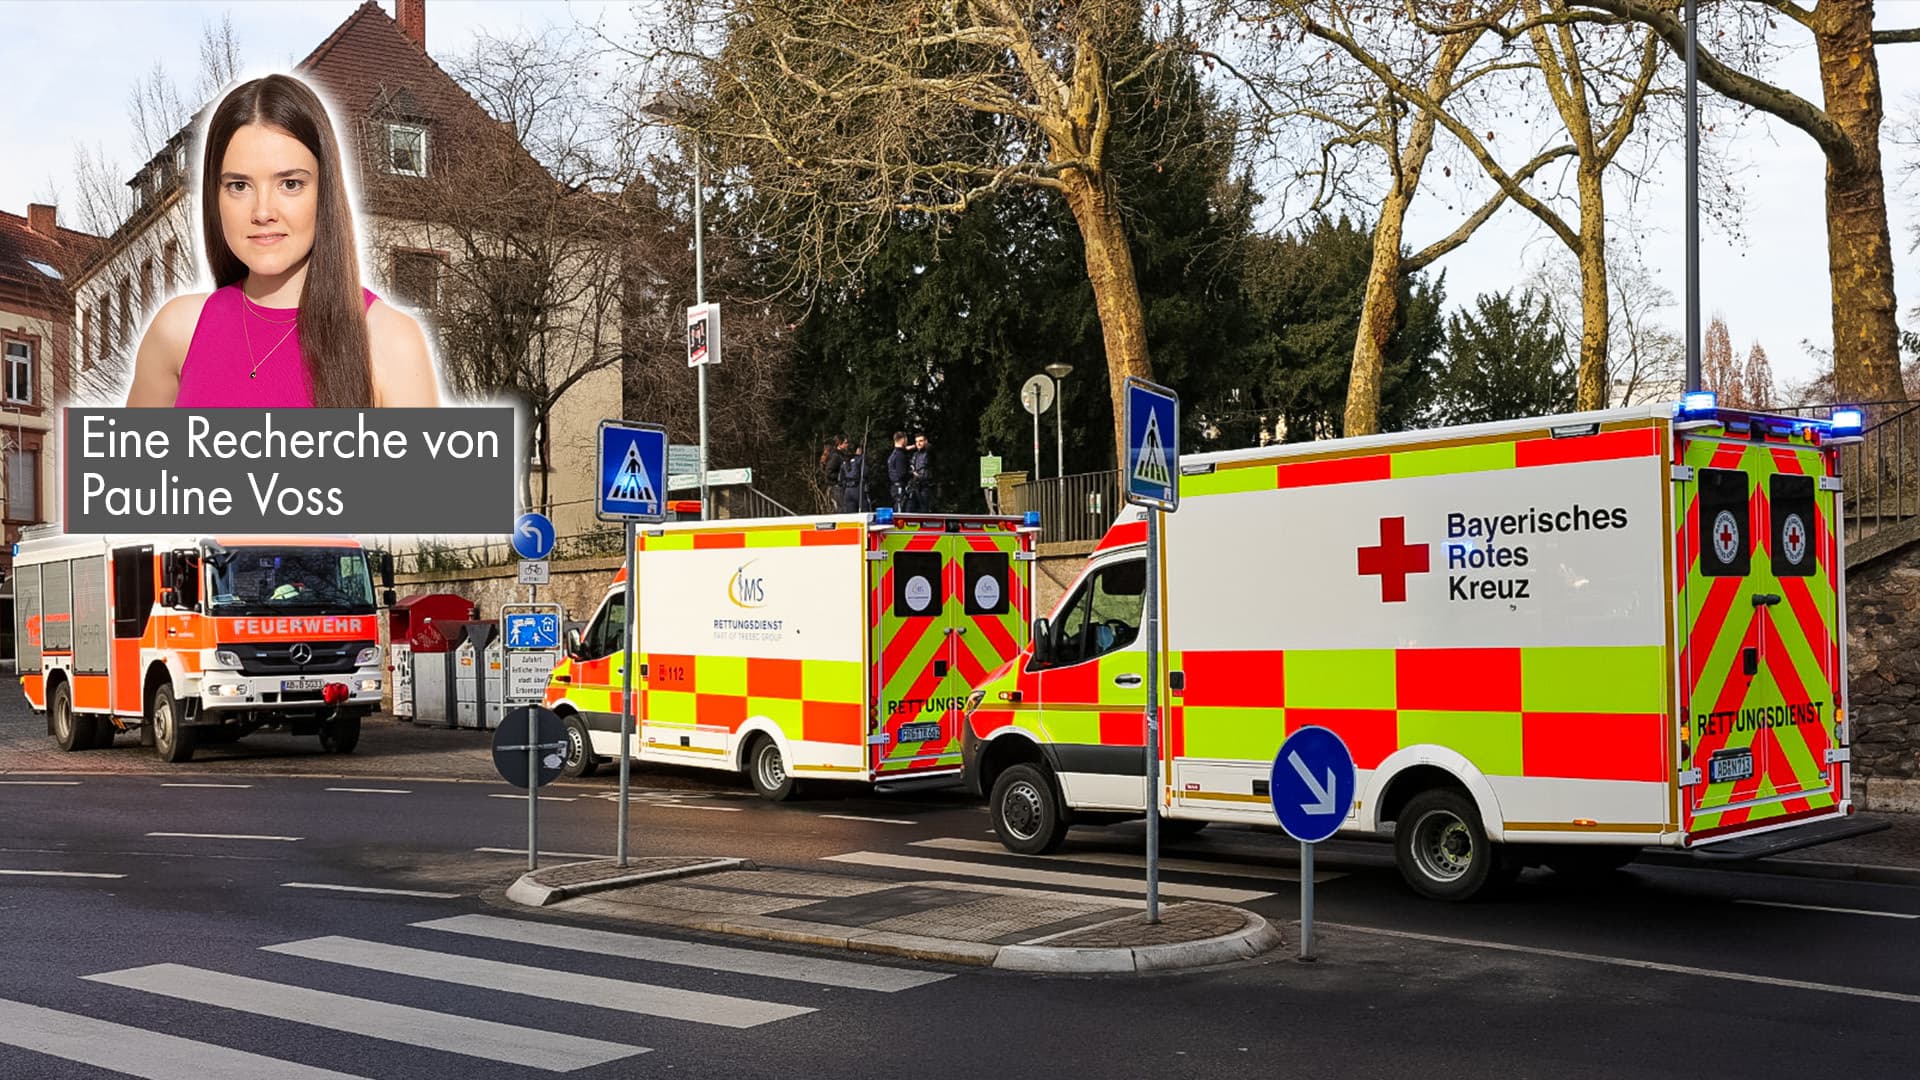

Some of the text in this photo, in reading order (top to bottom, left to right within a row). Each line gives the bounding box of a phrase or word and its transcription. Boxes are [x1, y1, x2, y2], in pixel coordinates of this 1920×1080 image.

[1448, 504, 1628, 542] Bayerisches
[1448, 544, 1529, 569] Rotes
[1449, 575, 1530, 600] Kreuz
[233, 618, 363, 635] FEUERWEHR
[713, 619, 783, 630] RETTUNGSDIENST
[669, 666, 684, 681] 112
[887, 696, 970, 715] RETTUNGS
[1697, 702, 1824, 737] RETTUNGSDIENST
